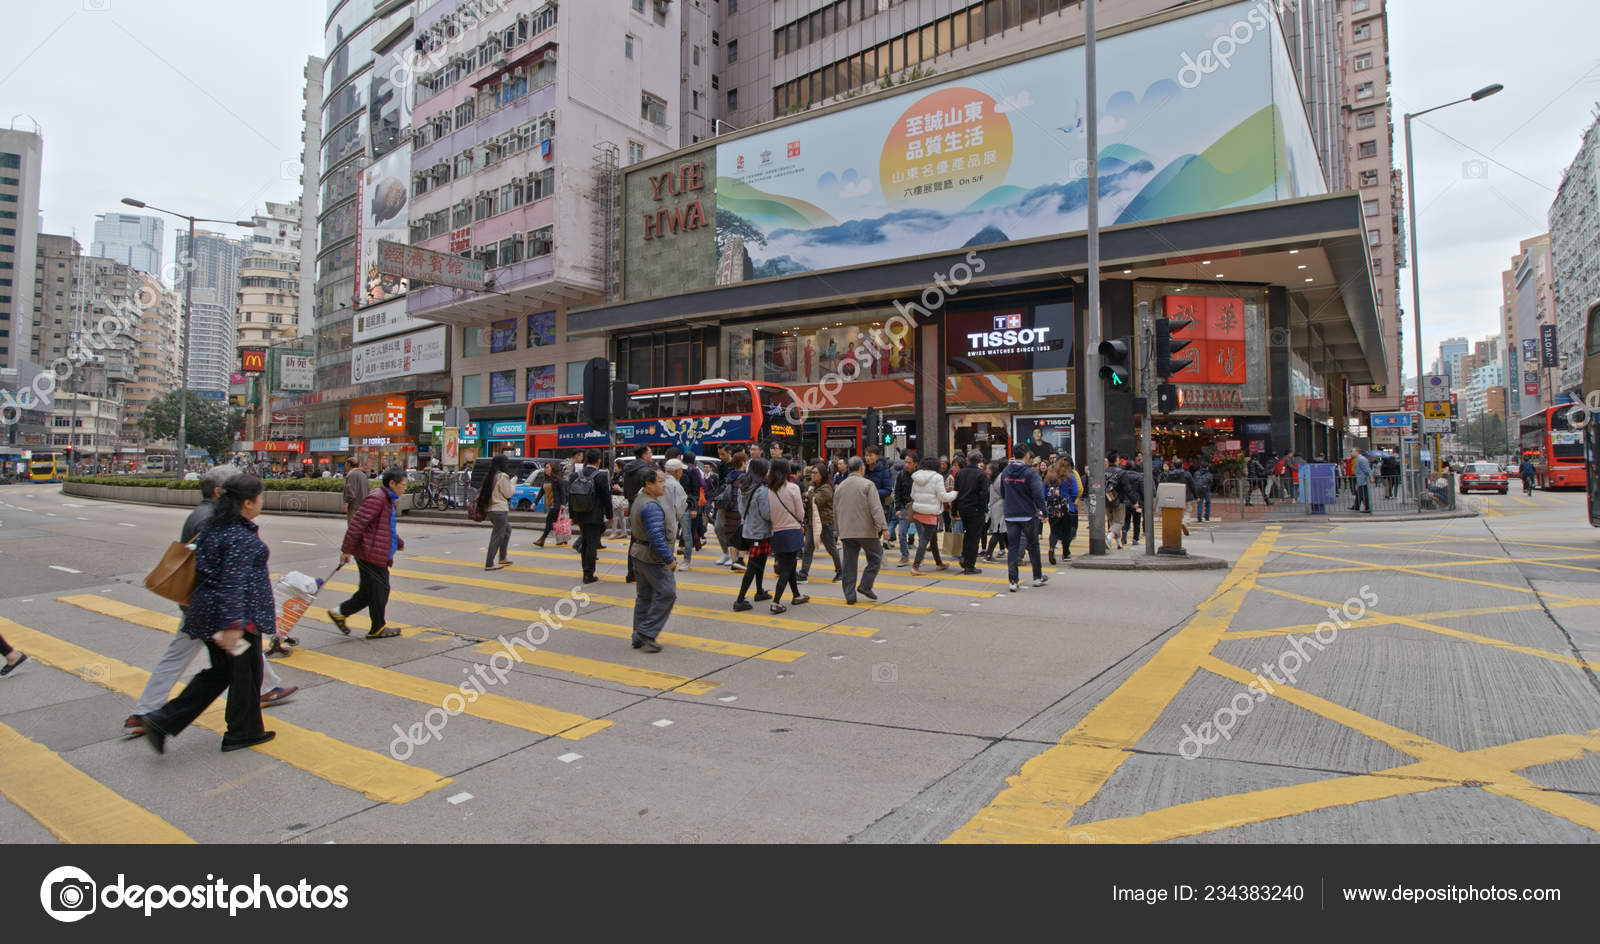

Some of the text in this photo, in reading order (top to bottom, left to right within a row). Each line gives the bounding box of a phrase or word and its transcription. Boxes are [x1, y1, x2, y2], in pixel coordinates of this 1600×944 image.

[905, 101, 983, 138] 至誠山東
[905, 125, 984, 161] 品質生活
[649, 161, 705, 201] YUE
[892, 150, 997, 184] 山東名優產品展
[959, 177, 970, 185] On
[972, 175, 984, 183] 5/F
[643, 200, 709, 241] HWA
[967, 327, 1050, 348] TISSOT
[495, 424, 522, 433] watsons
